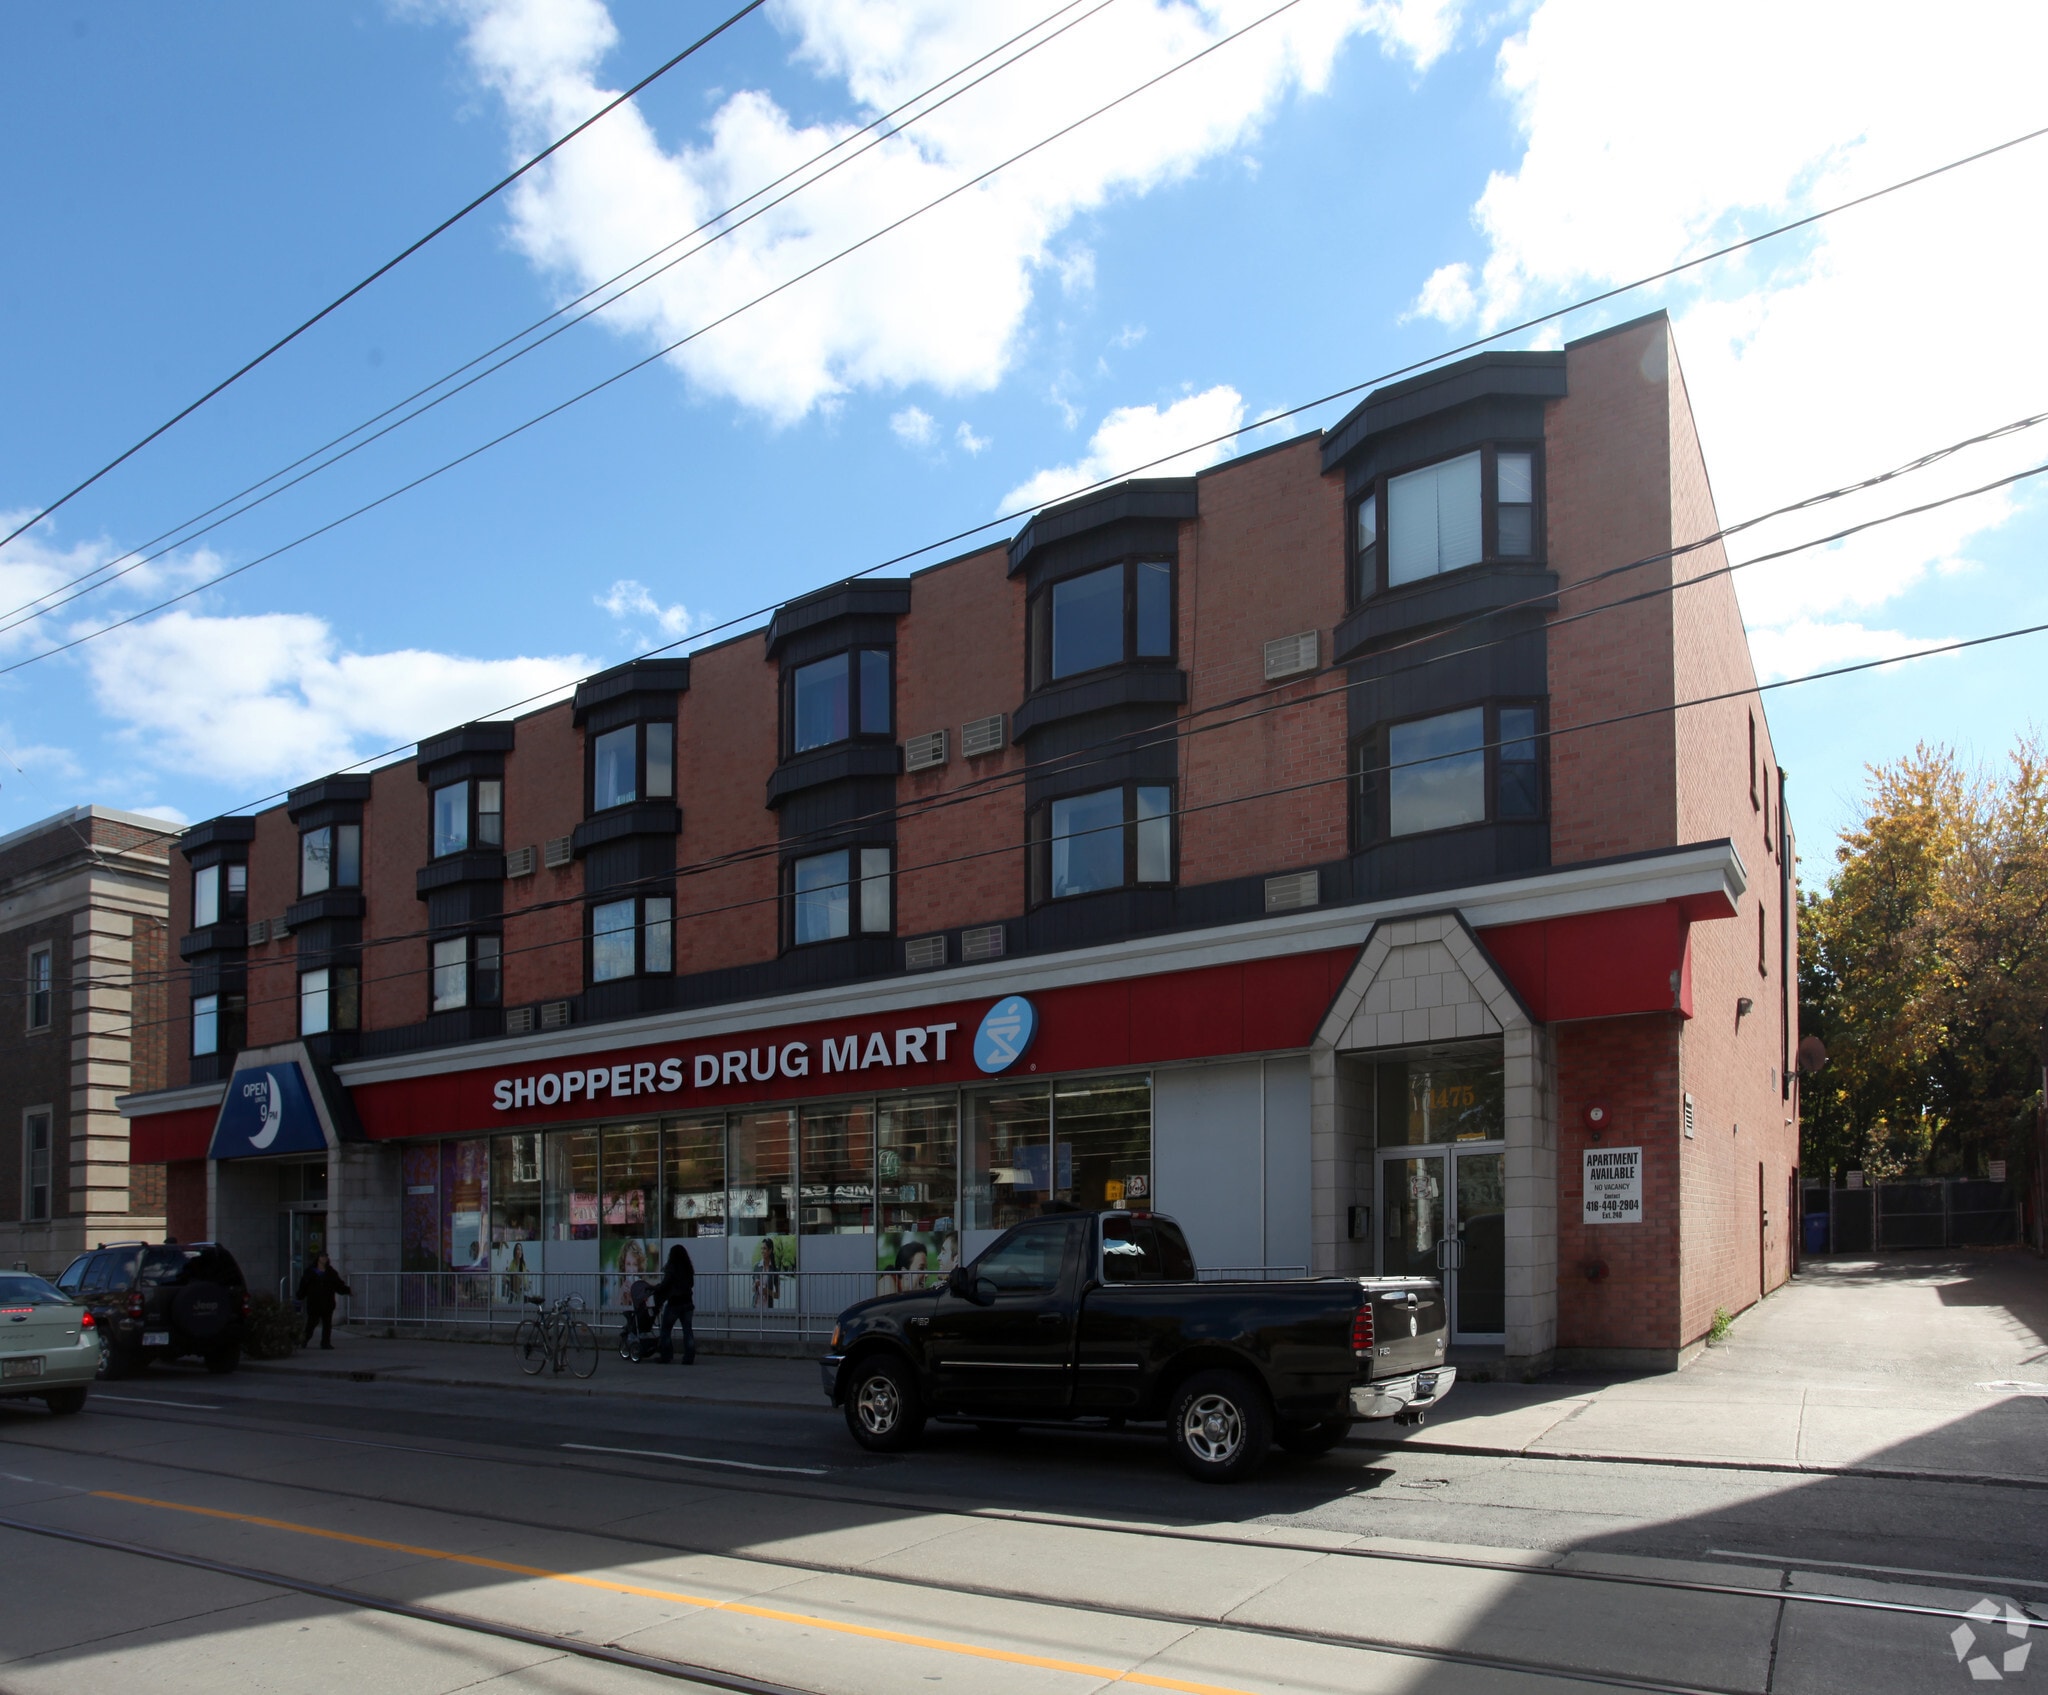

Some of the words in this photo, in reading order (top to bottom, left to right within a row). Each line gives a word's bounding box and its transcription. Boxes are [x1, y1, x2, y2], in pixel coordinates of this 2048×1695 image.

[492, 1058, 683, 1110] SHOPPERS
[694, 1042, 808, 1088] DRUG
[821, 1022, 957, 1073] MART
[243, 1082, 267, 1097] OPEN
[1429, 1086, 1475, 1109] 1475
[260, 1104, 268, 1122] 9
[268, 1111, 278, 1120] PM
[1587, 1152, 1638, 1167] APARTMENT
[1591, 1167, 1634, 1180] AVAILABLE
[1586, 1200, 1639, 1211] 416-440-2904
[193, 1301, 217, 1310] Jeep
